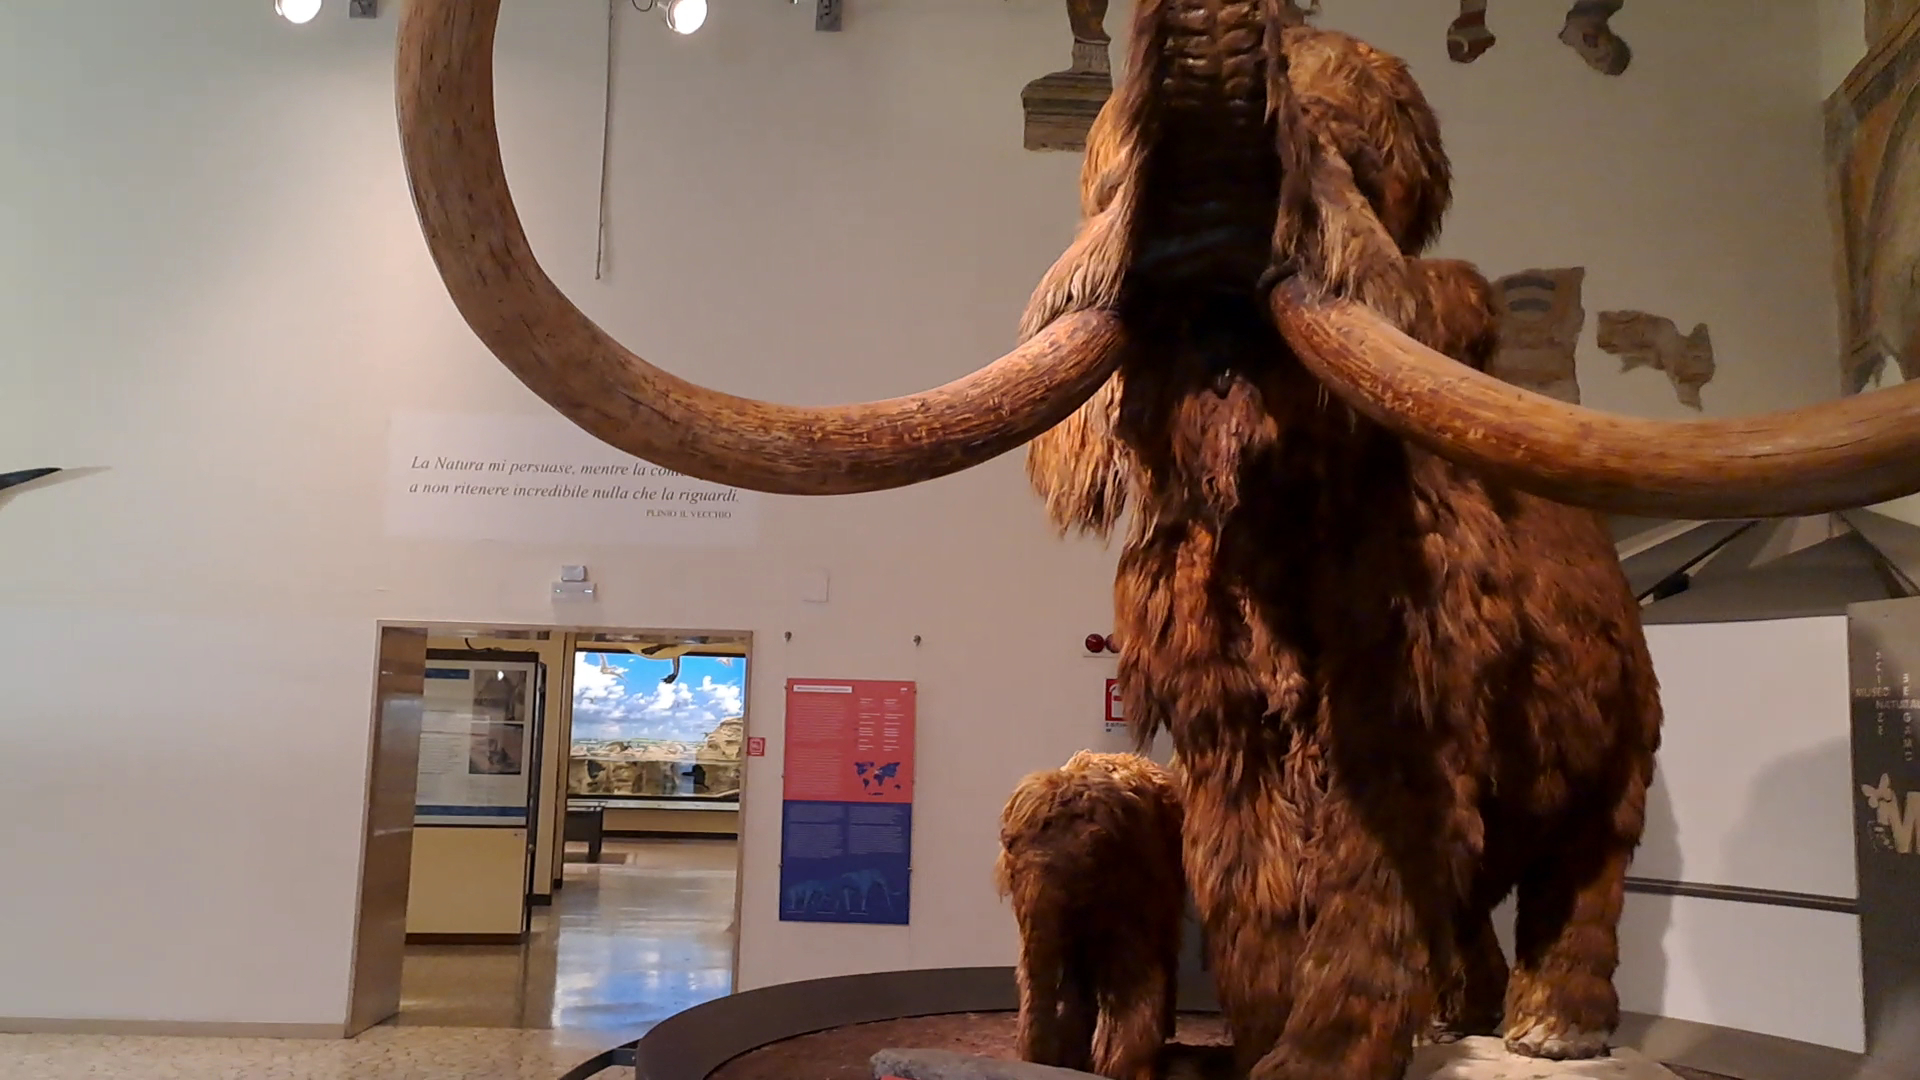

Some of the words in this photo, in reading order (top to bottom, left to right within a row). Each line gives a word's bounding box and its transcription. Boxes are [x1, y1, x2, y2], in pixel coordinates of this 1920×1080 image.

[411, 456, 430, 469] La
[434, 457, 484, 471] Natura
[488, 460, 507, 472] mi
[508, 462, 576, 476] persuase,
[580, 464, 629, 476] mentre
[632, 463, 647, 476] la
[409, 483, 419, 494] a
[422, 483, 449, 494] non
[453, 482, 510, 496] ritenere
[513, 484, 589, 499] incredibile
[592, 485, 629, 500] nulla
[632, 486, 657, 501] che
[661, 487, 675, 501] la
[678, 488, 741, 505] riguardi.
[690, 510, 732, 519] VECCHIO
